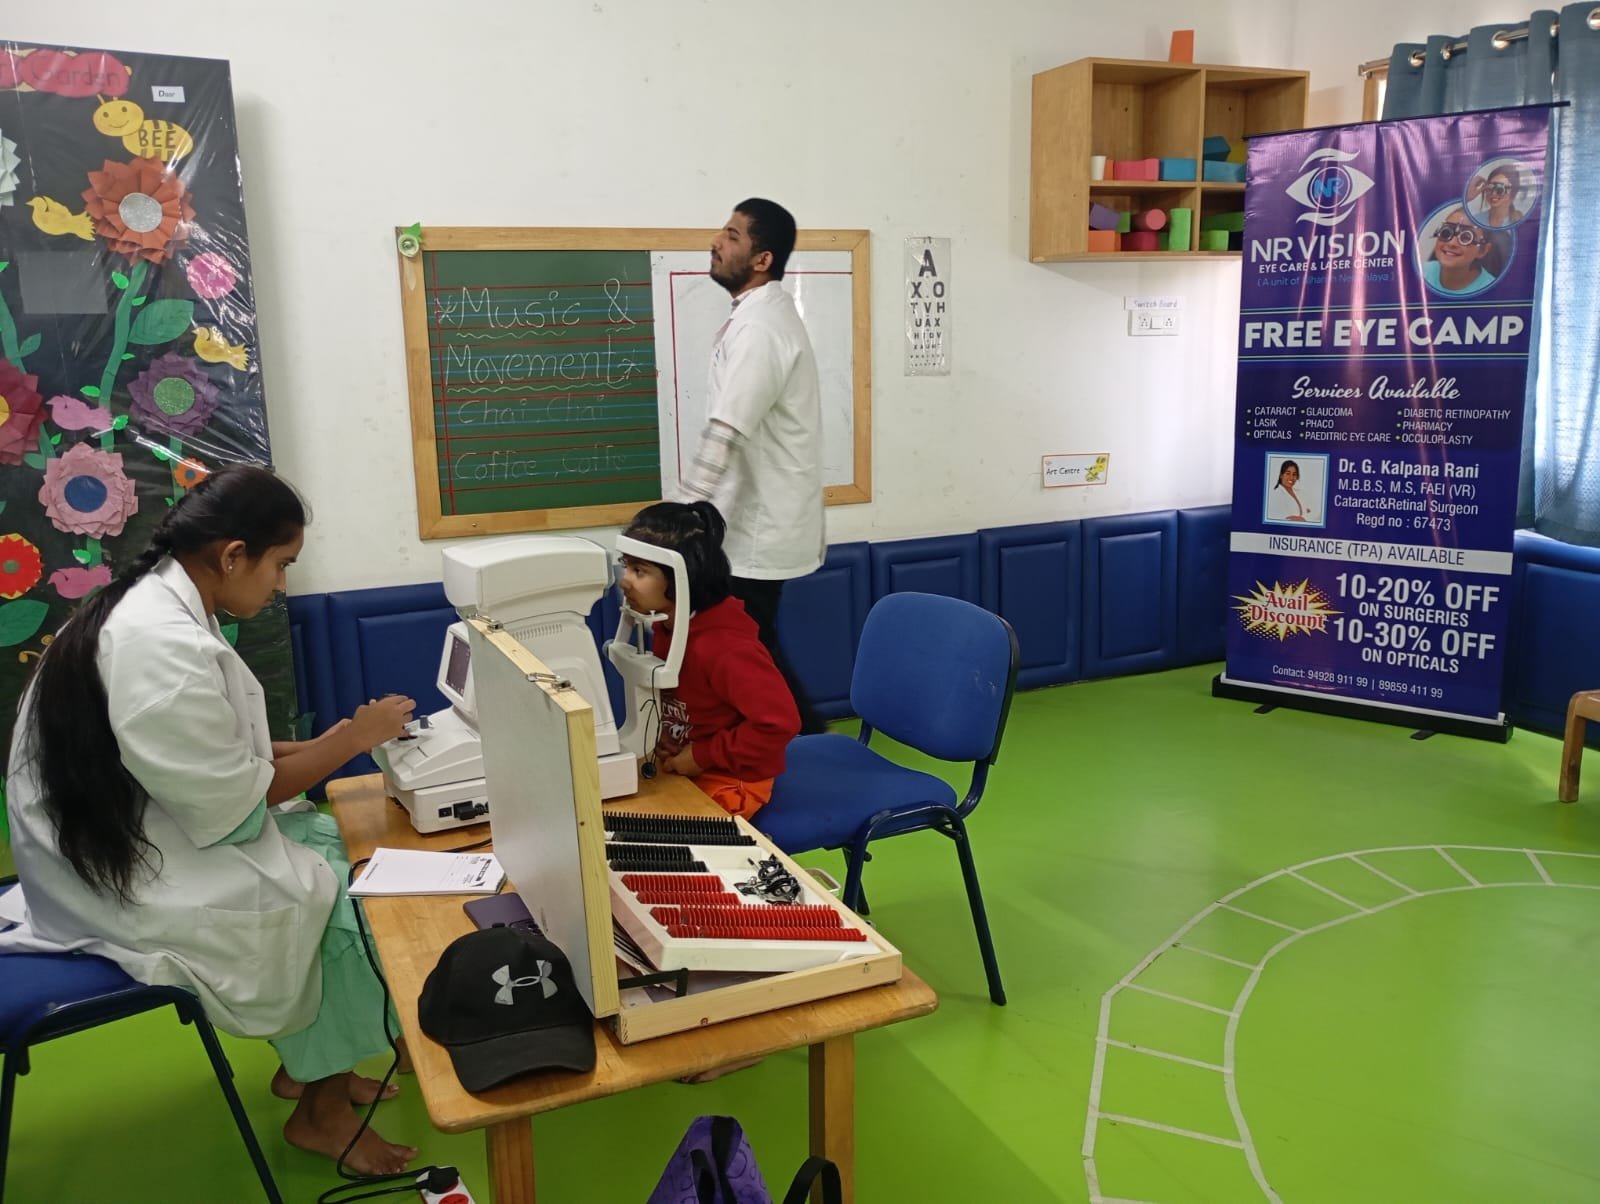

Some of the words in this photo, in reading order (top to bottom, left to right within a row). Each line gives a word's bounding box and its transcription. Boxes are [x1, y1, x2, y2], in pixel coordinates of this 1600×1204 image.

[138, 129, 177, 149] BEE
[1251, 237, 1293, 262] NR
[1298, 230, 1405, 259] VISION
[918, 249, 937, 277] A
[1259, 264, 1277, 274] EYE
[1280, 262, 1308, 272] CARE
[1310, 262, 1318, 271] &
[1320, 260, 1350, 270] LASER
[1354, 258, 1394, 269] CENTER
[458, 286, 581, 328] Music
[604, 278, 637, 325] &
[1244, 321, 1322, 348] FREE
[1334, 318, 1398, 346] EYE
[1408, 316, 1524, 346] CAMP
[446, 335, 624, 385] Movement
[1292, 376, 1363, 399] Services
[1368, 376, 1460, 400] Available
[1254, 407, 1296, 415] CATARACT
[1306, 407, 1353, 416] GLAUCOMA
[1404, 408, 1442, 418] DIABETIC
[1445, 409, 1510, 420] RETINOPATHY
[1254, 418, 1278, 427] LASIK
[1306, 420, 1334, 428] PHACO
[1402, 421, 1453, 431] PHARMACY
[1254, 430, 1292, 439] OPTICALS
[1305, 431, 1348, 441] PAEDITRIC
[1350, 433, 1365, 441] EYE
[1368, 433, 1391, 442] CARE
[1402, 433, 1473, 445] OCCULOPLASTY
[1339, 458, 1357, 473] Dr.
[1362, 460, 1376, 474] G.
[1381, 460, 1439, 478] Kalpana
[1444, 462, 1479, 478] Rani
[1338, 479, 1386, 494] M.B.B.S,
[1390, 481, 1416, 495] M.S,
[1420, 482, 1445, 496] FAEI
[1449, 484, 1475, 500] (VR)
[1334, 495, 1426, 512] Cataract&Retinal
[1430, 500, 1478, 516] Surgeon
[1356, 513, 1384, 528] Regd
[1388, 517, 1402, 526] no
[1414, 517, 1450, 531] 67473
[1269, 537, 1342, 556] INSURANCE
[1348, 542, 1382, 561] (TPA)
[1387, 545, 1464, 566] AVAILABLE
[1265, 591, 1308, 611] Avail
[1336, 572, 1434, 606] 10-20%
[1445, 583, 1500, 612] OFF
[1248, 605, 1327, 629] Discount
[1359, 602, 1379, 617] ON
[1384, 605, 1469, 628] SURGERIES
[1333, 617, 1431, 652] 10-30%
[1442, 629, 1496, 660] OFF
[1362, 648, 1382, 663] ON
[1387, 651, 1459, 674] OPTICALS
[1272, 665, 1306, 678] Contact:
[1307, 670, 1334, 682] 94928
[1337, 675, 1353, 685] 911
[1356, 677, 1368, 687] 99
[1379, 680, 1408, 693] 89859
[1410, 685, 1427, 696] 411
[1431, 688, 1443, 698] 99
